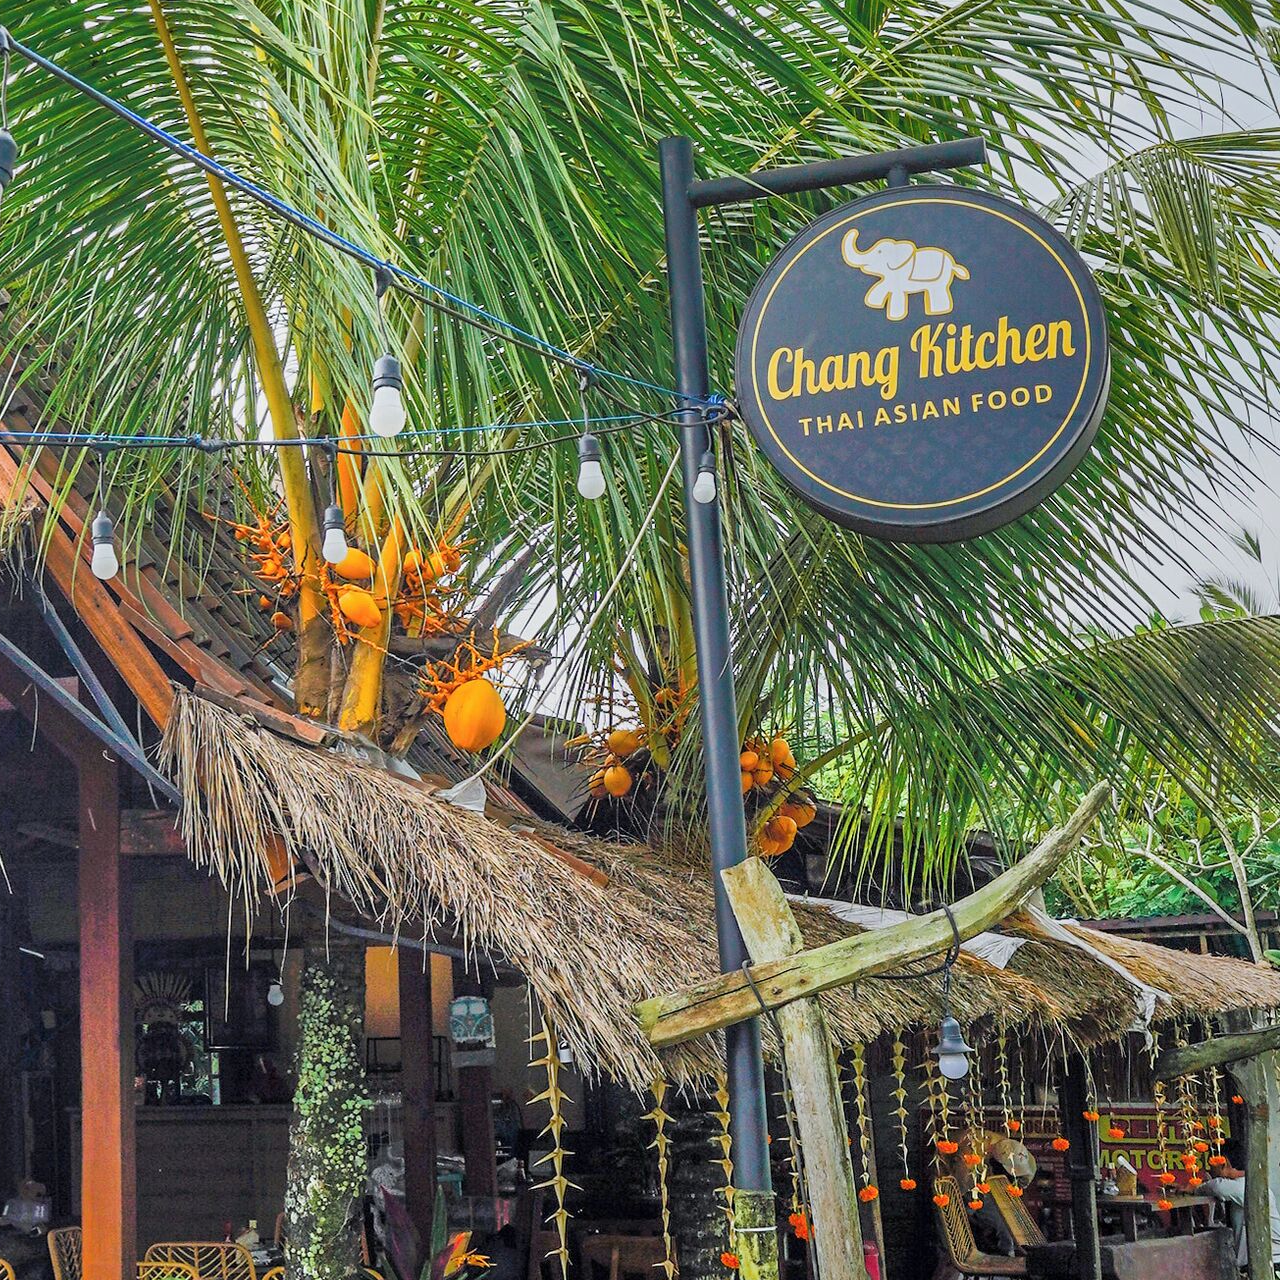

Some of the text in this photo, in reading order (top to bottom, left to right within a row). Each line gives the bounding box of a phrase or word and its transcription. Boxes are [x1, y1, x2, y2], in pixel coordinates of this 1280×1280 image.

[767, 315, 1076, 401] Chang Kitchen
[798, 384, 1054, 436] THAI ASIAN FOOD
